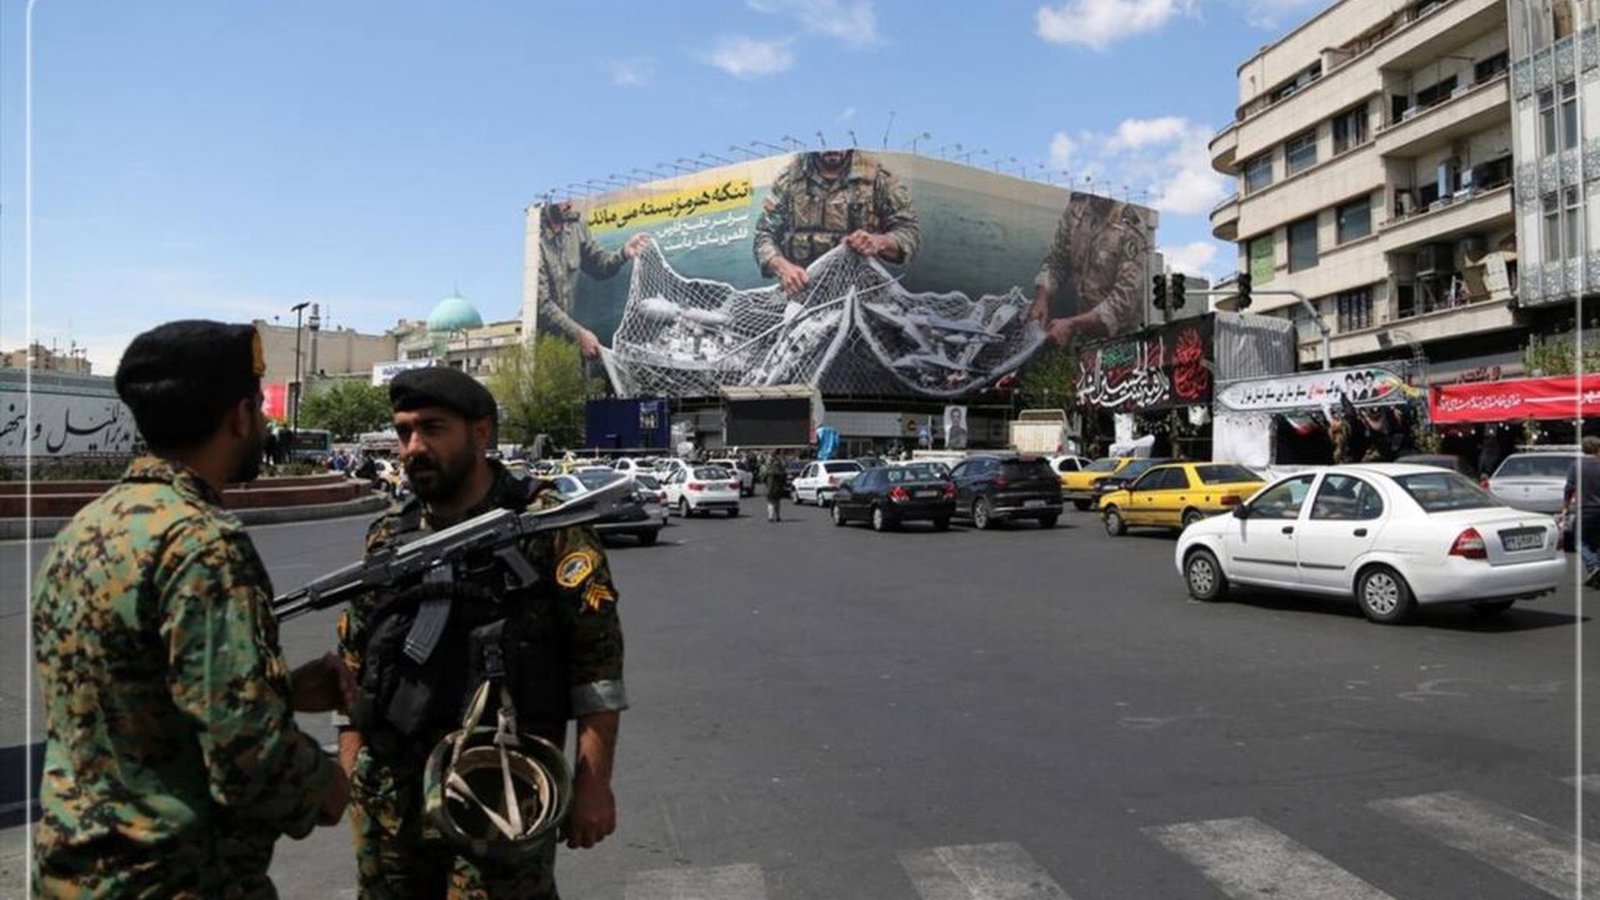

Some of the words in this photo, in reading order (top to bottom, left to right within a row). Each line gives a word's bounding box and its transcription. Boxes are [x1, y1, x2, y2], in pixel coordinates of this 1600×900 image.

[711, 182, 748, 202] تنگه
[638, 202, 674, 216] بسته
[674, 191, 709, 218] هرمز
